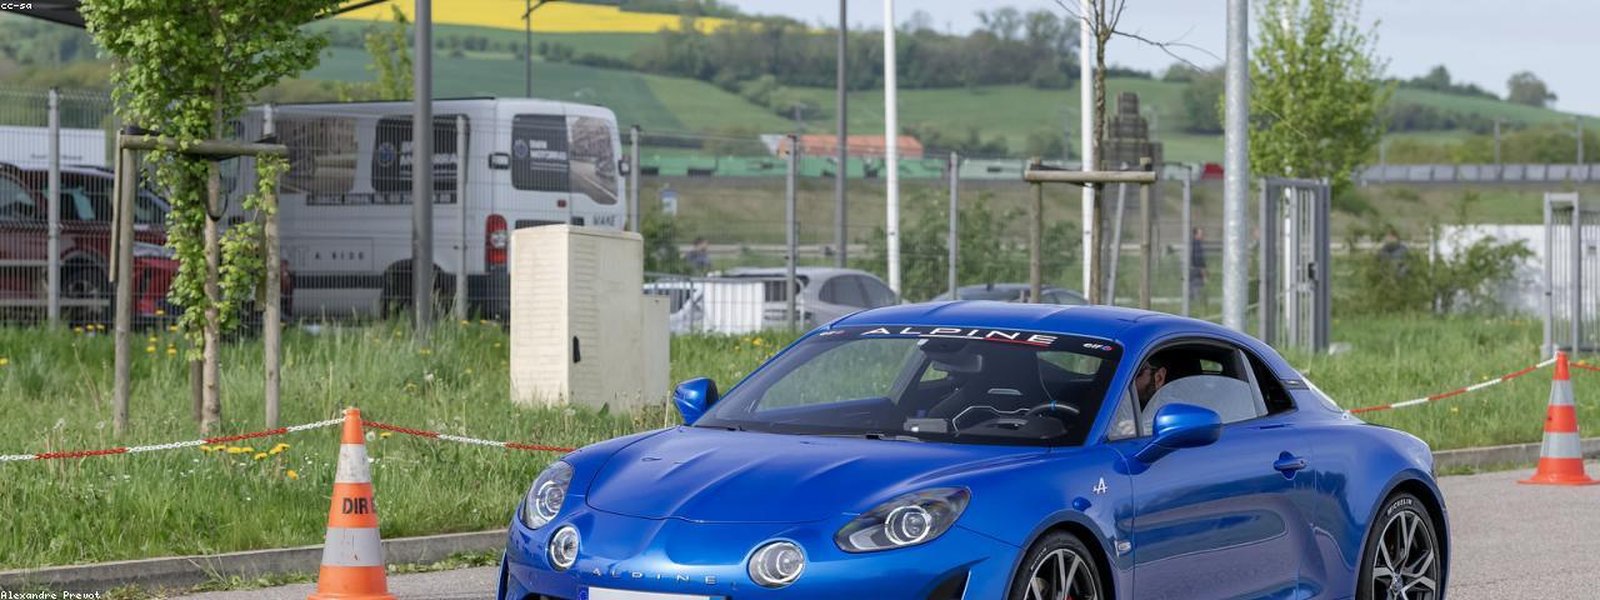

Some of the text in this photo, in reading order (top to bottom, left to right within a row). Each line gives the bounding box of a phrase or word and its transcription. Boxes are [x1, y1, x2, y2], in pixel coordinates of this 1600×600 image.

[861, 326, 1058, 344] ALPINE
[343, 498, 368, 514] DIR
[1387, 499, 1412, 515] MICHELIN
[592, 567, 717, 584] ALPINE
